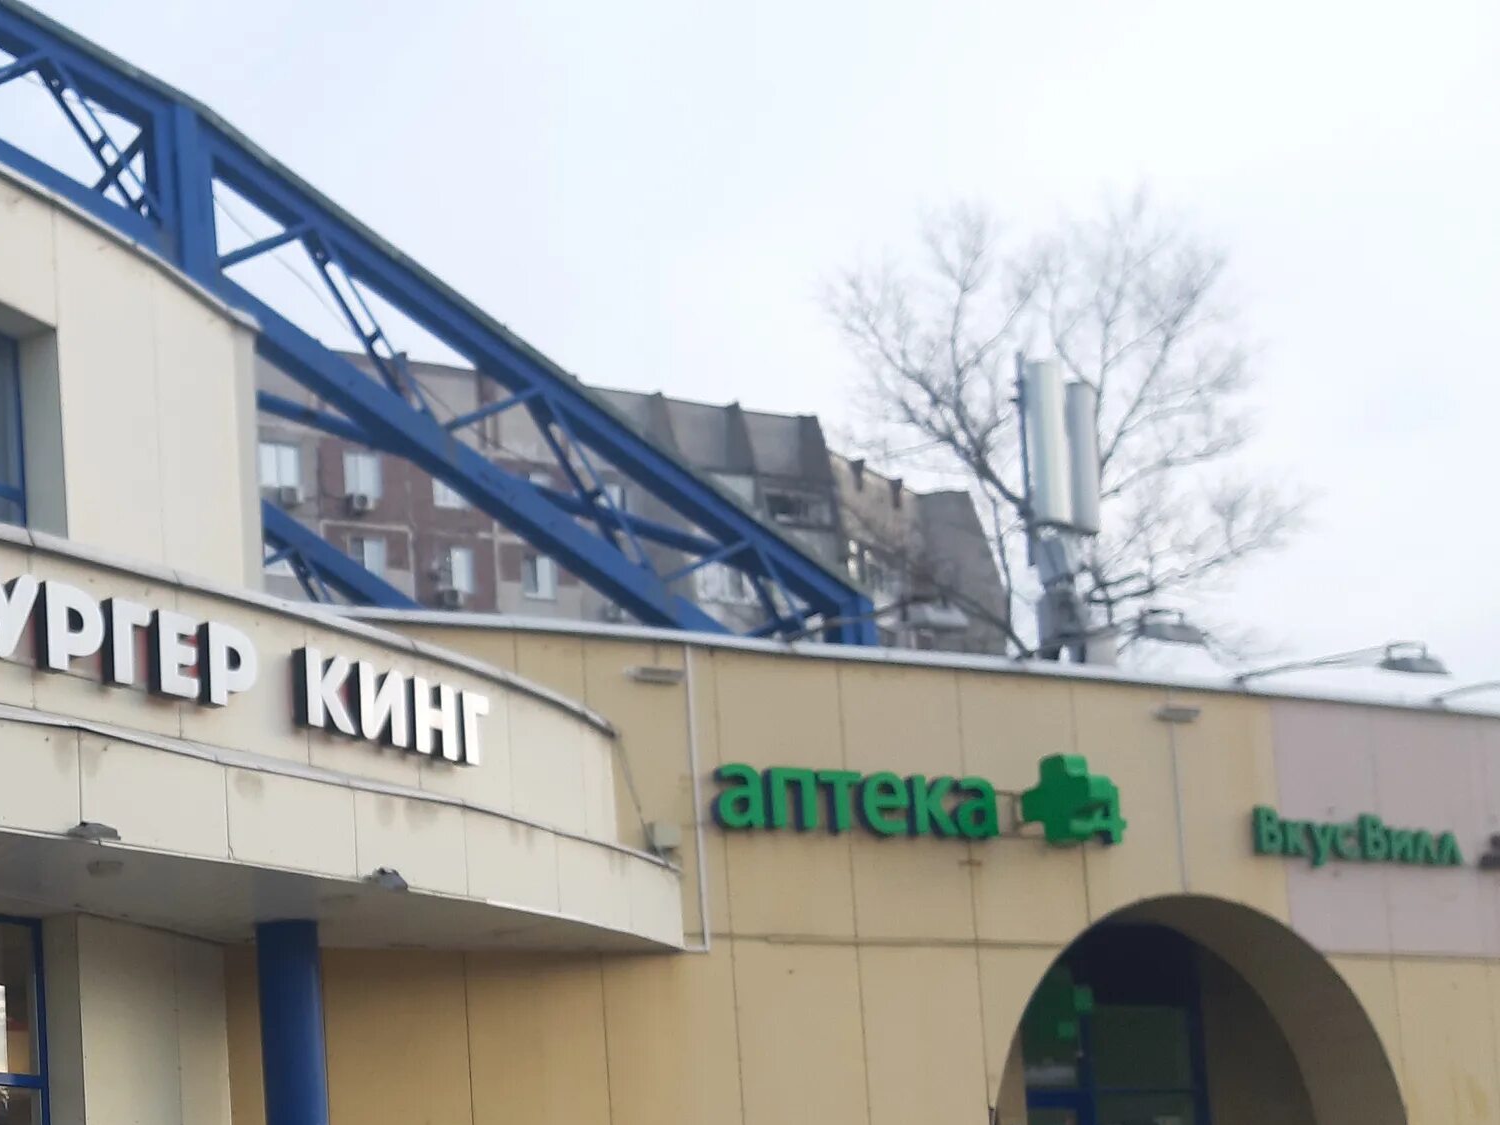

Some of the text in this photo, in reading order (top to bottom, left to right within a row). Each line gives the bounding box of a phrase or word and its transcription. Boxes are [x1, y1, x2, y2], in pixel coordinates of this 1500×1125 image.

[292, 645, 490, 767] КИНГ
[711, 762, 1000, 840] аптека
[1252, 804, 1464, 868] ВкусВилл
